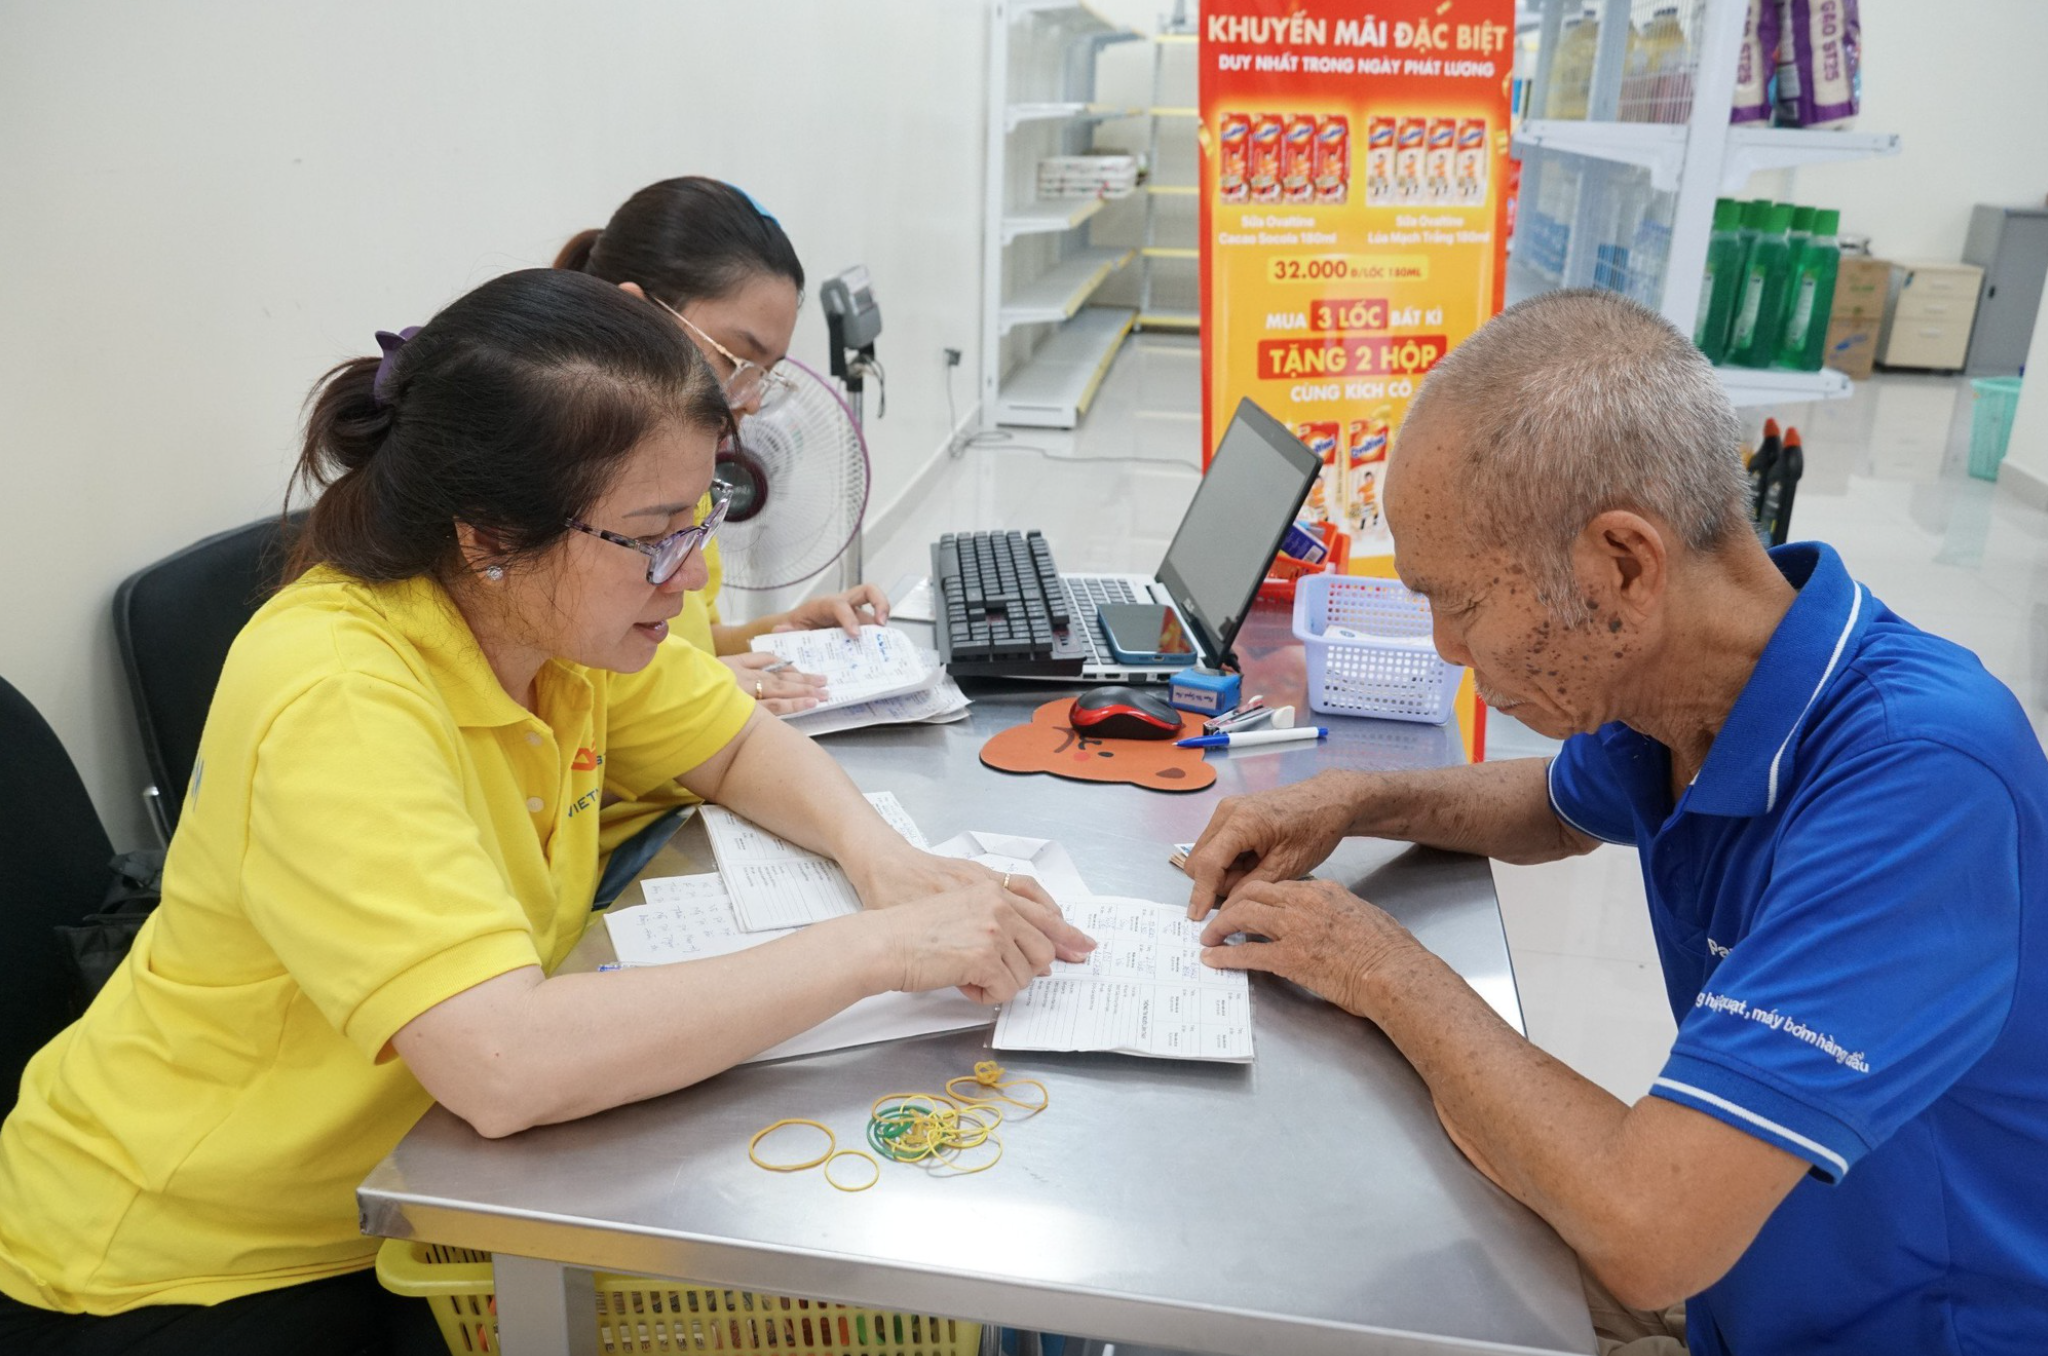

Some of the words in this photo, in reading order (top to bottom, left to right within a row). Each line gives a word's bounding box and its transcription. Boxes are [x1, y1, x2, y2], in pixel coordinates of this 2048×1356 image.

[1208, 10, 1327, 46] KHUYẾN
[1334, 15, 1387, 48] MÃI
[1393, 17, 1449, 53] ĐẶC
[1456, 20, 1509, 56] BIỆT
[1218, 54, 1252, 71] DUY
[1255, 51, 1300, 73] NHẤT
[1302, 56, 1354, 74] TRONG
[1357, 55, 1402, 75] NGÀY
[1404, 56, 1441, 76] PHÁT
[1443, 59, 1495, 77] LƯƠNG
[1218, 231, 1257, 245] Cacao
[1274, 260, 1348, 279] 32.000
[1265, 312, 1307, 330] MUA
[1317, 306, 1331, 329] 3
[1338, 300, 1382, 328] LỐC
[1390, 305, 1422, 326] BẤT
[1269, 343, 1348, 378] TẶNG
[1355, 345, 1373, 371] 2
[1380, 339, 1438, 375] HỘP
[1290, 382, 1340, 402] CÙNG
[1345, 381, 1384, 400] KÍCH
[1752, 1008, 1785, 1030] máy
[1783, 1016, 1817, 1044] bơm
[1815, 1033, 1848, 1064] hàng
